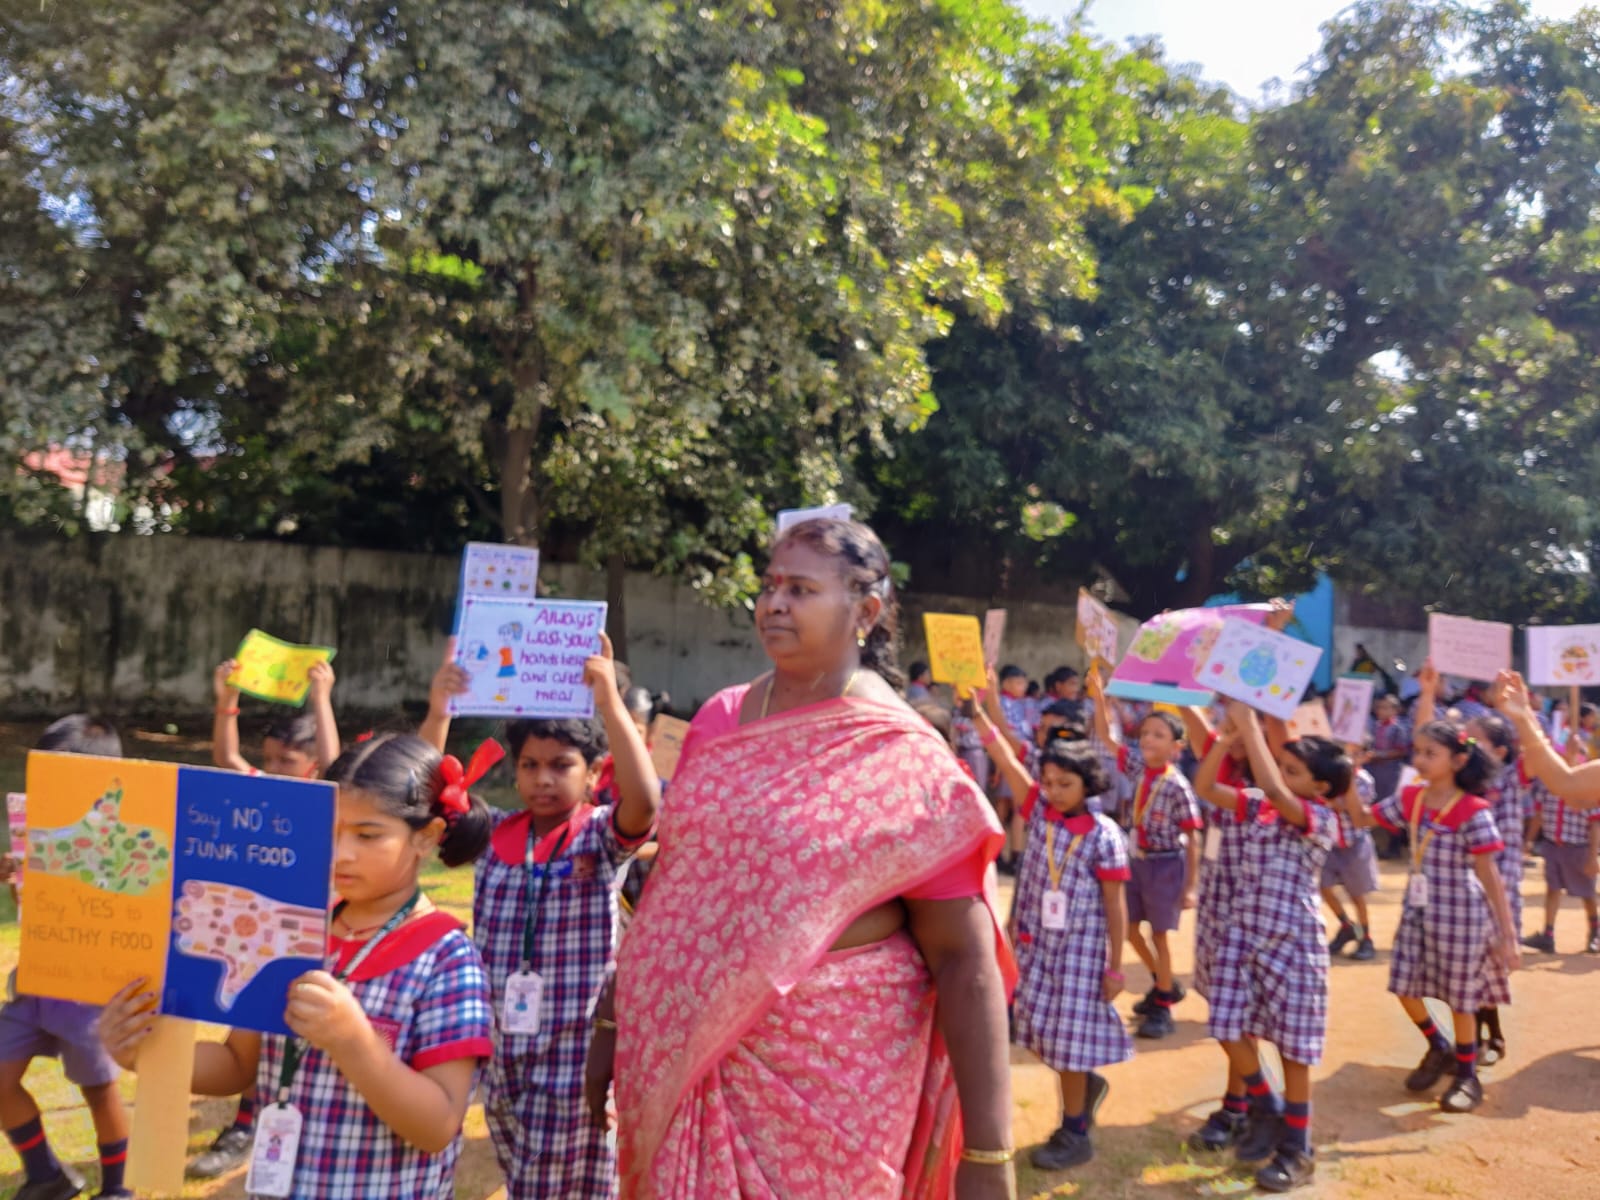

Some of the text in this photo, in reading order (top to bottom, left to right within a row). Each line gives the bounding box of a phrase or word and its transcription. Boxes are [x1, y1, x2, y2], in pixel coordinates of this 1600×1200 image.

[534, 608, 595, 630] Always
[535, 688, 573, 701] meal
[187, 803, 221, 839] Say
[271, 813, 293, 836] to
[183, 836, 297, 869] JUNK FOOD
[34, 890, 67, 923] Say
[126, 904, 143, 920] to
[26, 924, 154, 950] HEALTHY FOOD
